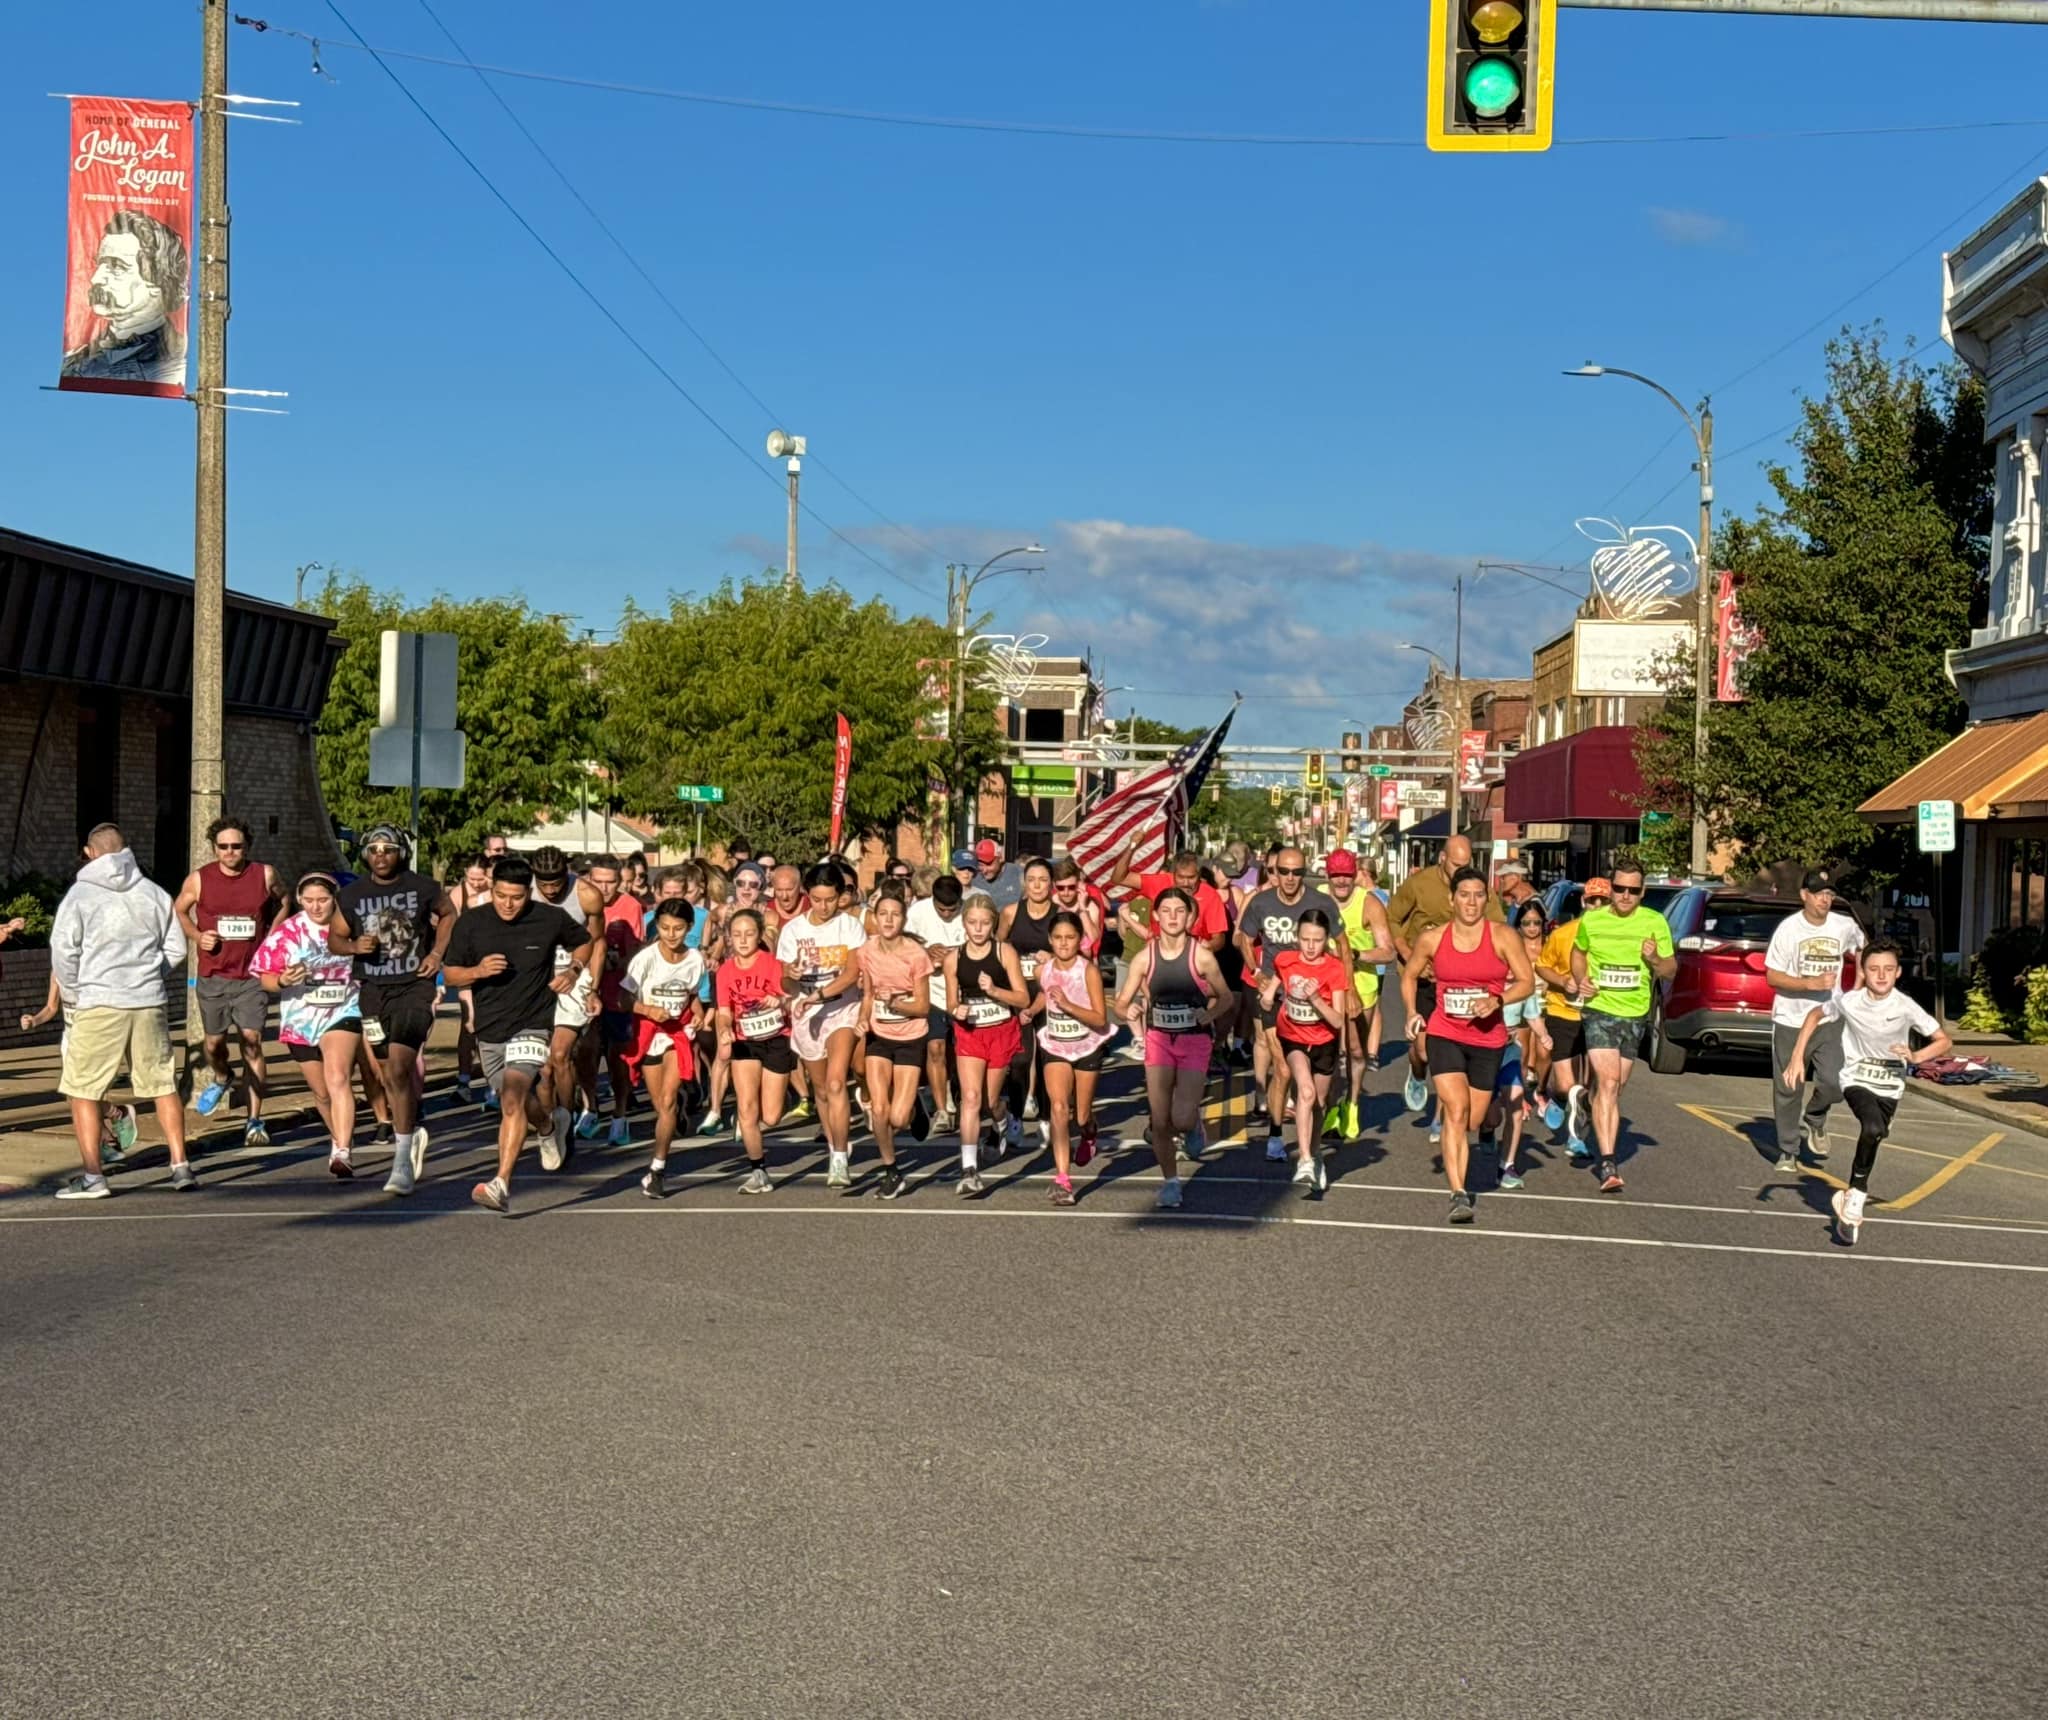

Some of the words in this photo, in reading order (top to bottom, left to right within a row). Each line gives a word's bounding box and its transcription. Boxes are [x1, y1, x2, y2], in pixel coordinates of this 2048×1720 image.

[85, 115, 113, 126] HOME
[116, 117, 129, 127] OF
[133, 117, 181, 131] GENERAL
[74, 129, 140, 172] John
[142, 133, 176, 160] A.
[117, 157, 189, 193] Logan
[165, 198, 180, 206] DAY
[680, 785, 701, 800] 12th
[354, 891, 418, 917] JUICE
[226, 924, 248, 933] 1261
[364, 956, 419, 977] WRLD
[729, 975, 771, 998] APPLE
[1608, 974, 1632, 984] 1275
[315, 989, 337, 999] 1263
[1161, 1013, 1185, 1024] 1291
